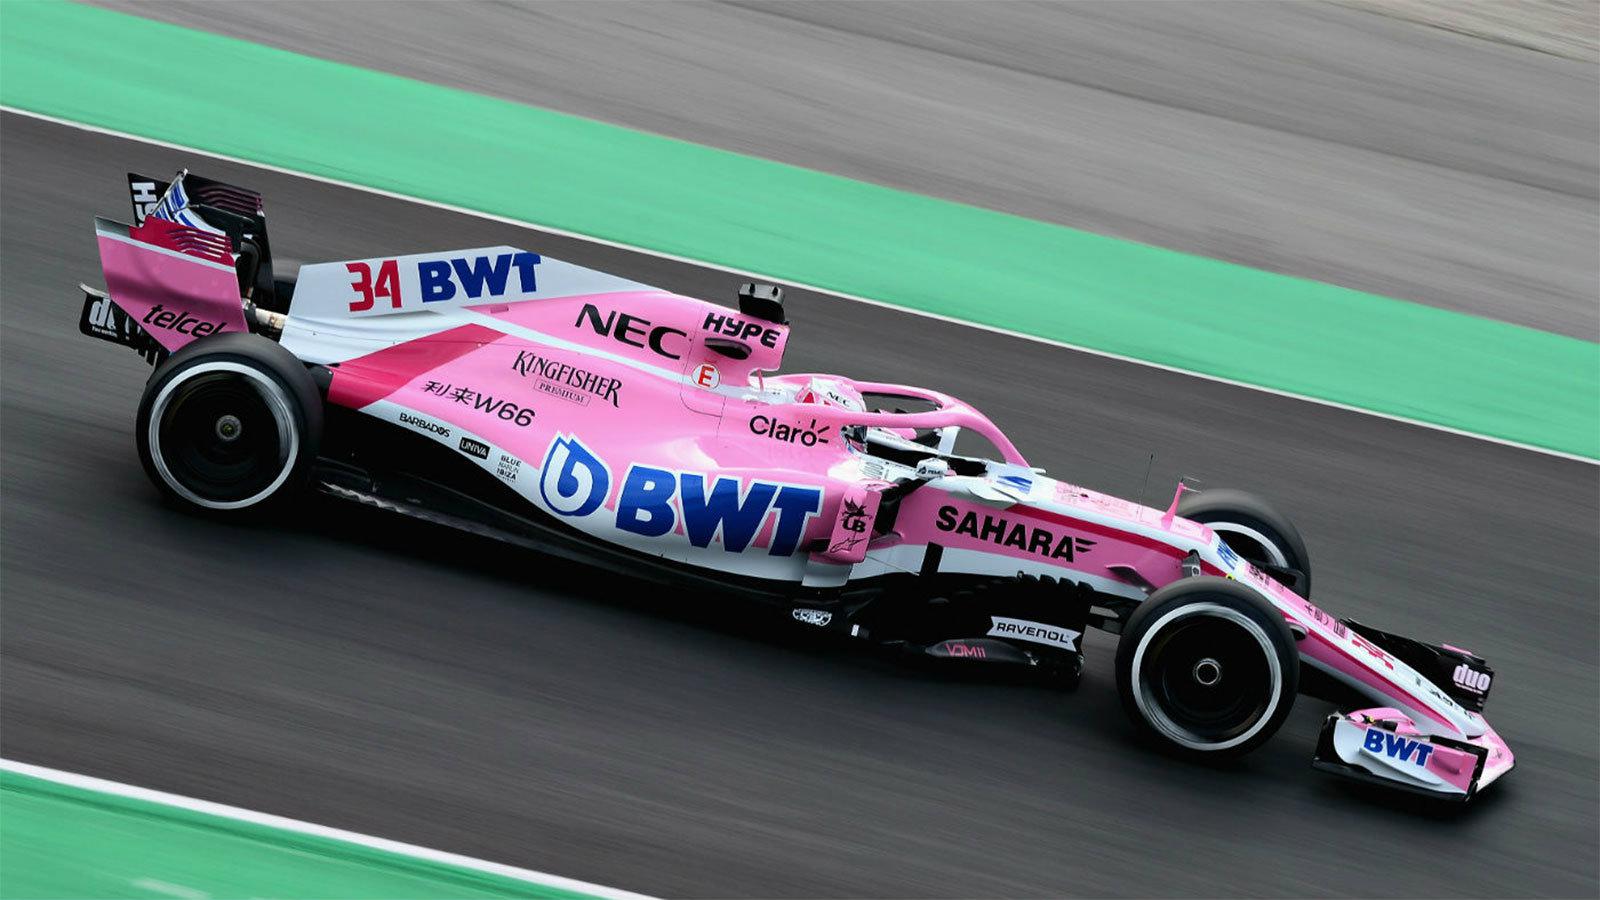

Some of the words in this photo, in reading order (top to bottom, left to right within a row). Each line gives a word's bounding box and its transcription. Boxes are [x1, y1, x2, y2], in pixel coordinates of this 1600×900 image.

[345, 260, 403, 312] 34
[418, 252, 541, 303] BWT
[143, 304, 227, 338] telcel
[575, 303, 688, 360] NEC
[703, 312, 781, 349] HYPE
[512, 350, 622, 408] KINGFISHER
[538, 382, 586, 403] PREMIUM
[697, 365, 715, 387] E
[399, 411, 451, 438] BARBADOS
[749, 414, 818, 447] Claro
[460, 439, 488, 457] UNIVA
[501, 454, 521, 467] BLUE
[615, 465, 821, 557] BWT
[936, 505, 1077, 563] SAHARA
[996, 622, 1069, 644] RAVENOL
[1453, 663, 1491, 691] duo
[1363, 728, 1435, 768] BWT
